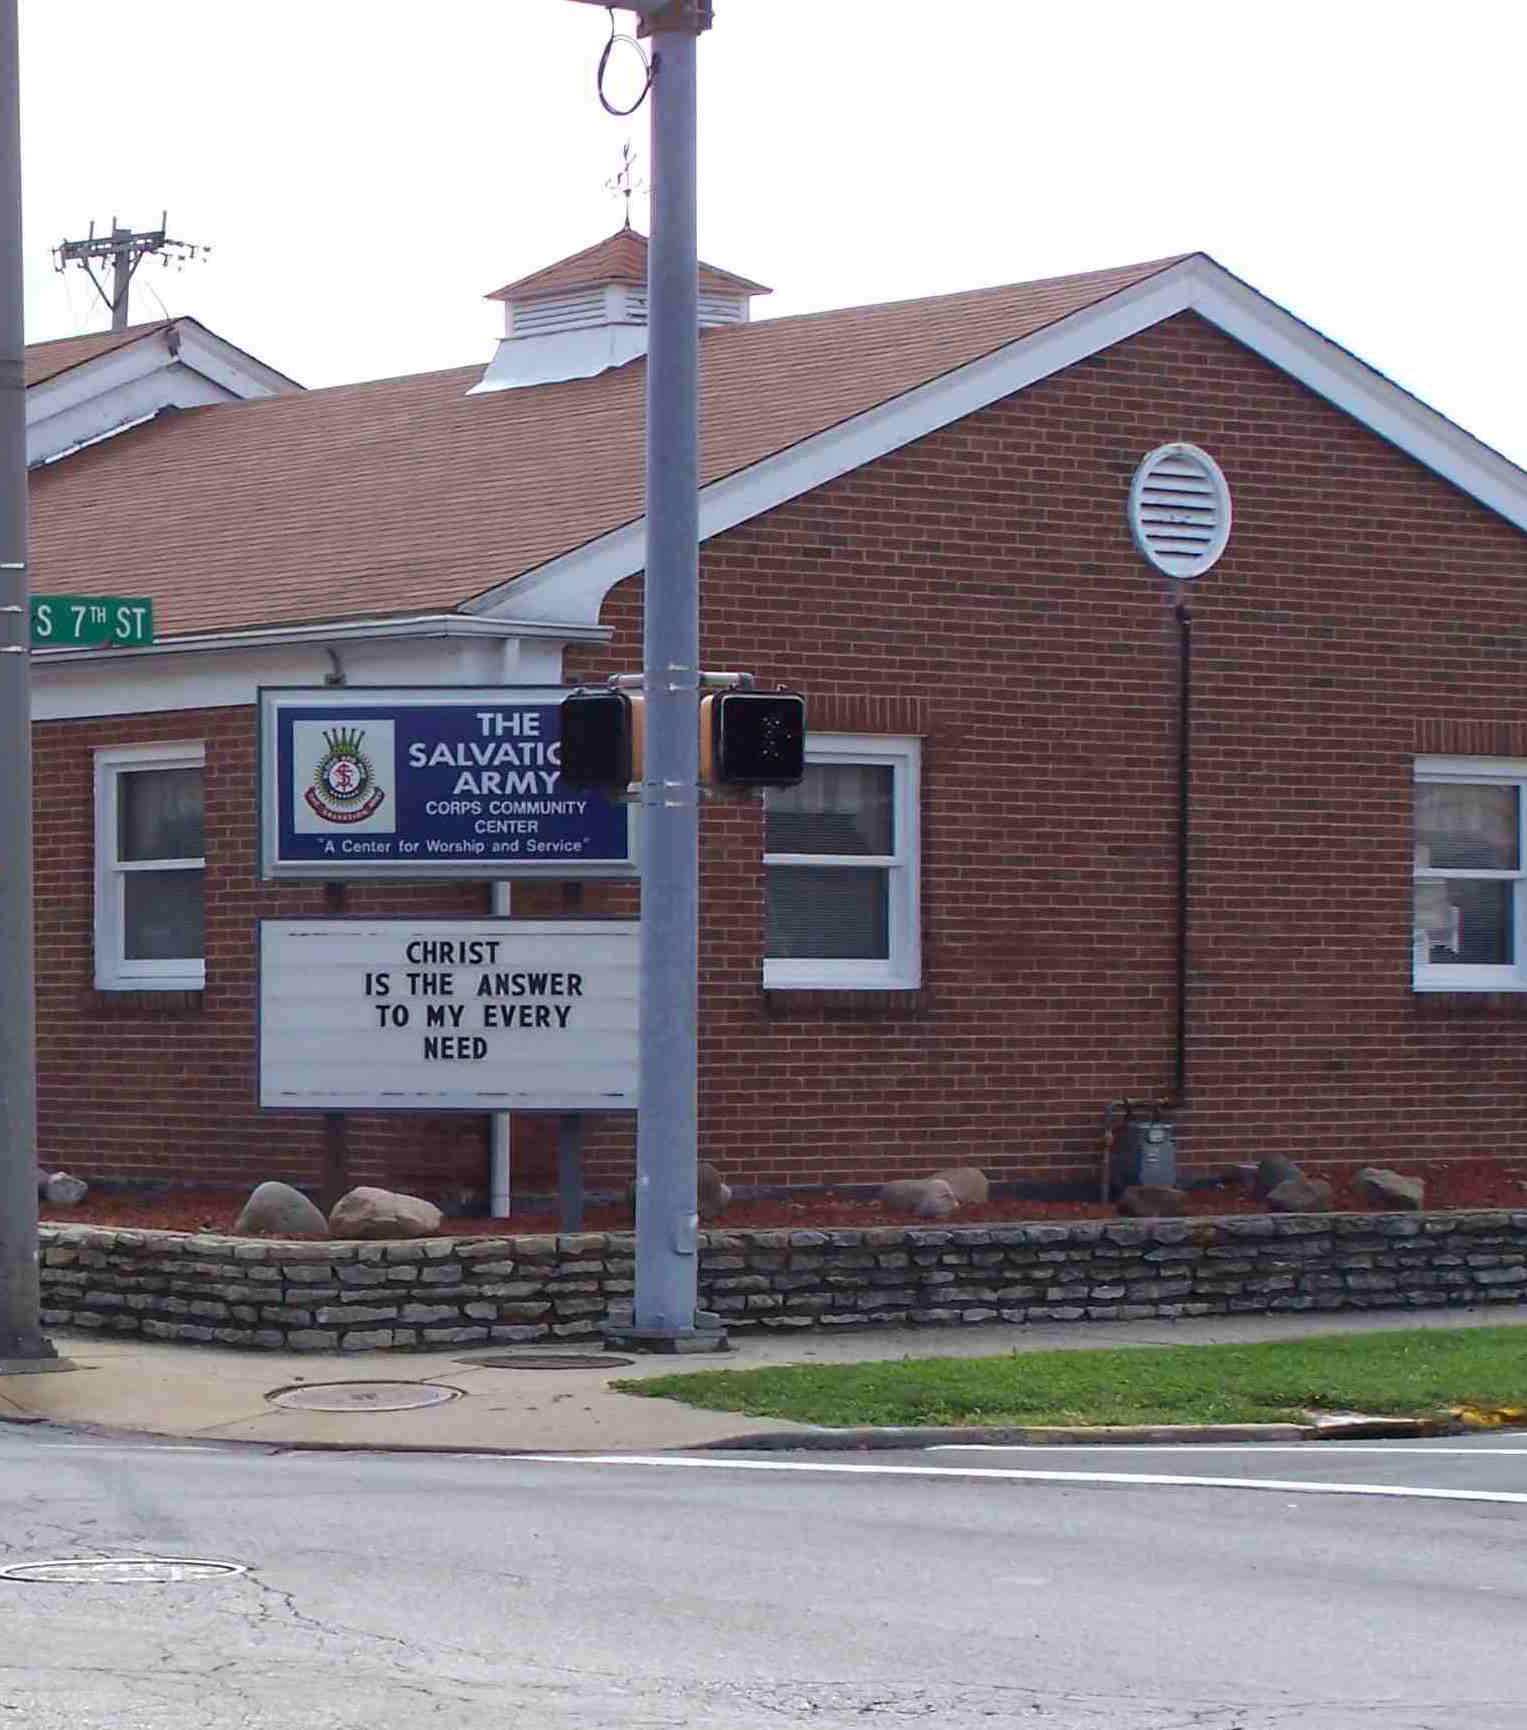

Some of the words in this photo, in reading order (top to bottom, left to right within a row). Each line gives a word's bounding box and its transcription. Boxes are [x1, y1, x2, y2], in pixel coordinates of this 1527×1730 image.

[37, 604, 53, 637] S
[71, 605, 107, 638] 7TH
[115, 606, 147, 639] ST
[476, 712, 540, 737] THE
[408, 741, 561, 768] SALVATIO
[452, 770, 561, 795] ARMY
[425, 800, 482, 816] CORPS
[488, 800, 587, 816] COMMUNITY
[474, 819, 539, 834] CENTER
[341, 839, 391, 853] Center
[398, 839, 420, 853] for
[426, 839, 485, 855] Worship
[492, 839, 520, 853] and
[526, 837, 591, 853] Service"
[406, 940, 500, 965] CHRIST
[365, 972, 390, 997] IS
[405, 972, 454, 996] THE
[477, 972, 583, 997] ANSWER
[375, 1004, 410, 1028] TO
[426, 1004, 465, 1028] MY
[484, 1004, 572, 1028] EVERY
[423, 1036, 488, 1060] NEED
